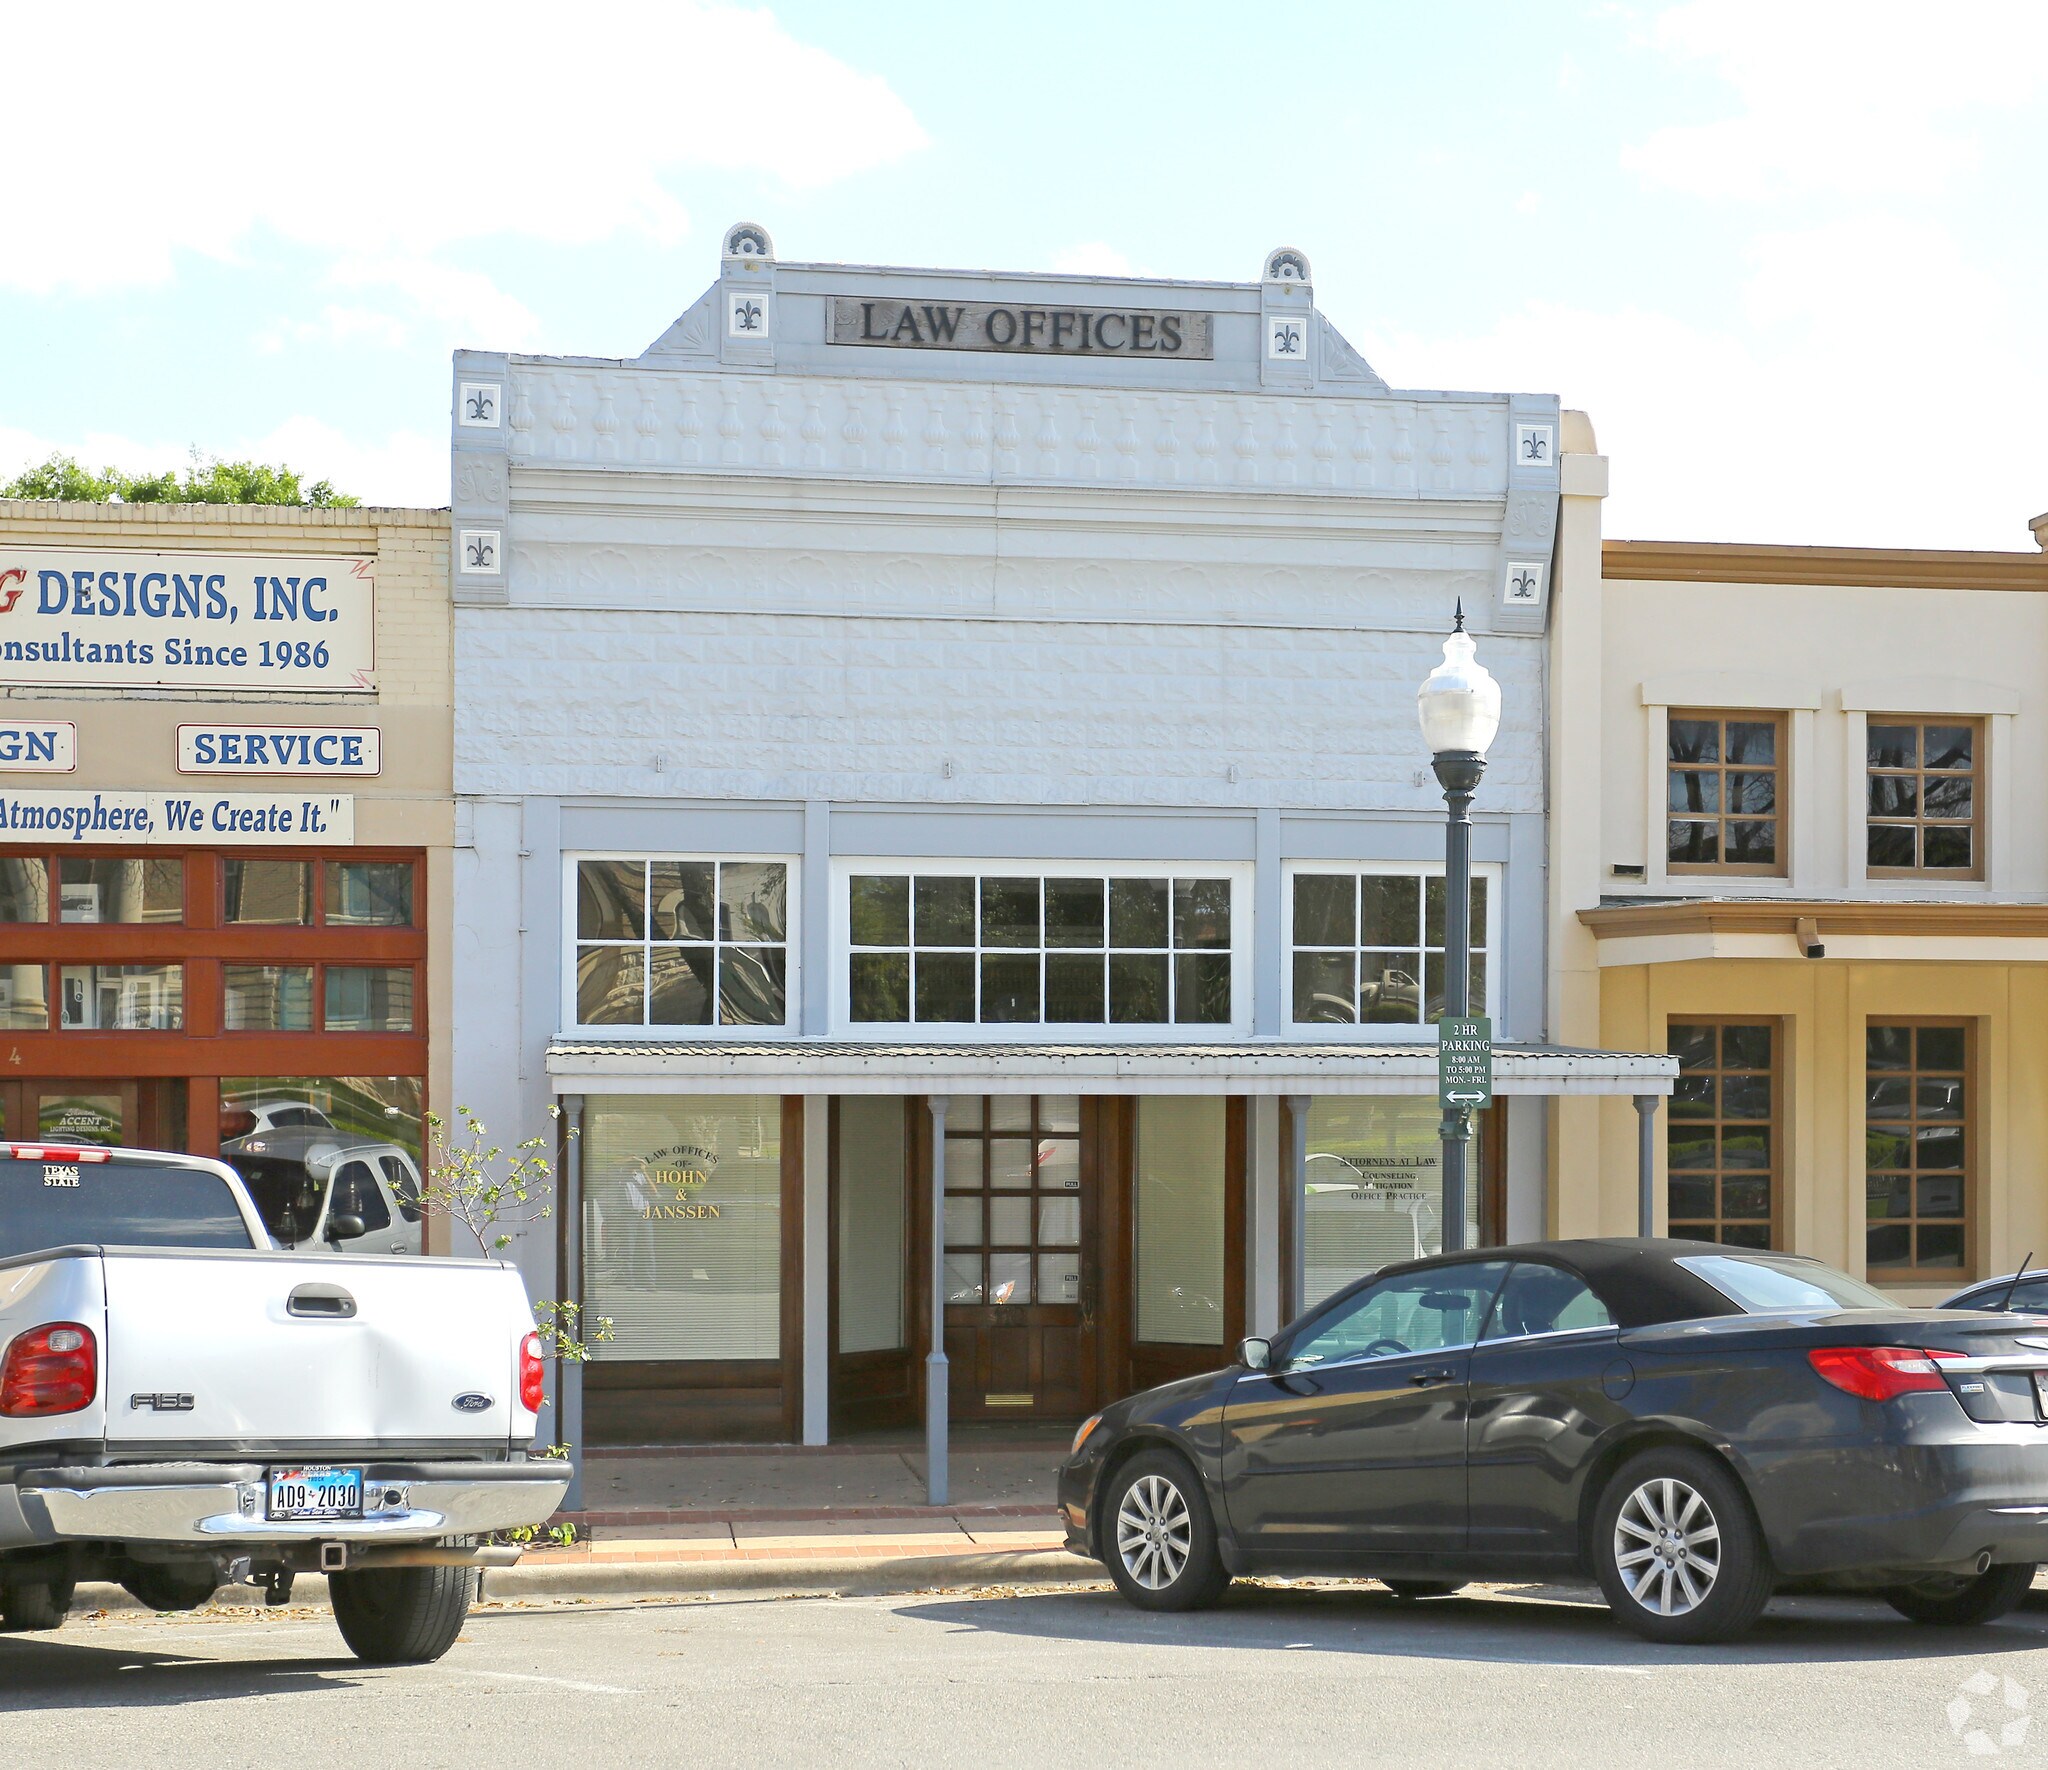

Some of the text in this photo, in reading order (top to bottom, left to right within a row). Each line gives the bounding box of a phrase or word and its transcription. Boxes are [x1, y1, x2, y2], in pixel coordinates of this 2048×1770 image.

[859, 303, 1183, 353] LAW OFFICES
[37, 569, 239, 625] DESIGNS,
[253, 576, 339, 623] INC.
[0, 632, 330, 669] nsultants Since 1986
[194, 734, 364, 767] SERVICE
[164, 799, 204, 832] We
[212, 800, 293, 833] Create
[299, 798, 340, 834] It."
[1454, 1024, 1478, 1036] 2 HR
[1441, 1040, 1490, 1051] PARKING
[9, 1047, 22, 1065] 4
[1451, 1055, 1481, 1064] 8:00 AM
[1446, 1066, 1486, 1074] TO 5:00 PM
[1445, 1076, 1466, 1084] MON.
[1472, 1076, 1487, 1084] FRI.
[59, 1117, 102, 1126] ACCENT
[644, 1145, 720, 1164] LAW OFFICES
[1399, 1157, 1410, 1165] AT
[43, 1165, 79, 1176] TEXAS
[655, 1170, 708, 1184] HOHN
[1362, 1170, 1417, 1180] COUNSELING
[43, 1176, 81, 1188] STATE
[675, 1187, 687, 1201] &
[1351, 1191, 1427, 1200] OFFICE PRACTICE
[642, 1205, 720, 1219] JANSSEN
[277, 1485, 356, 1508] AD9 2030
